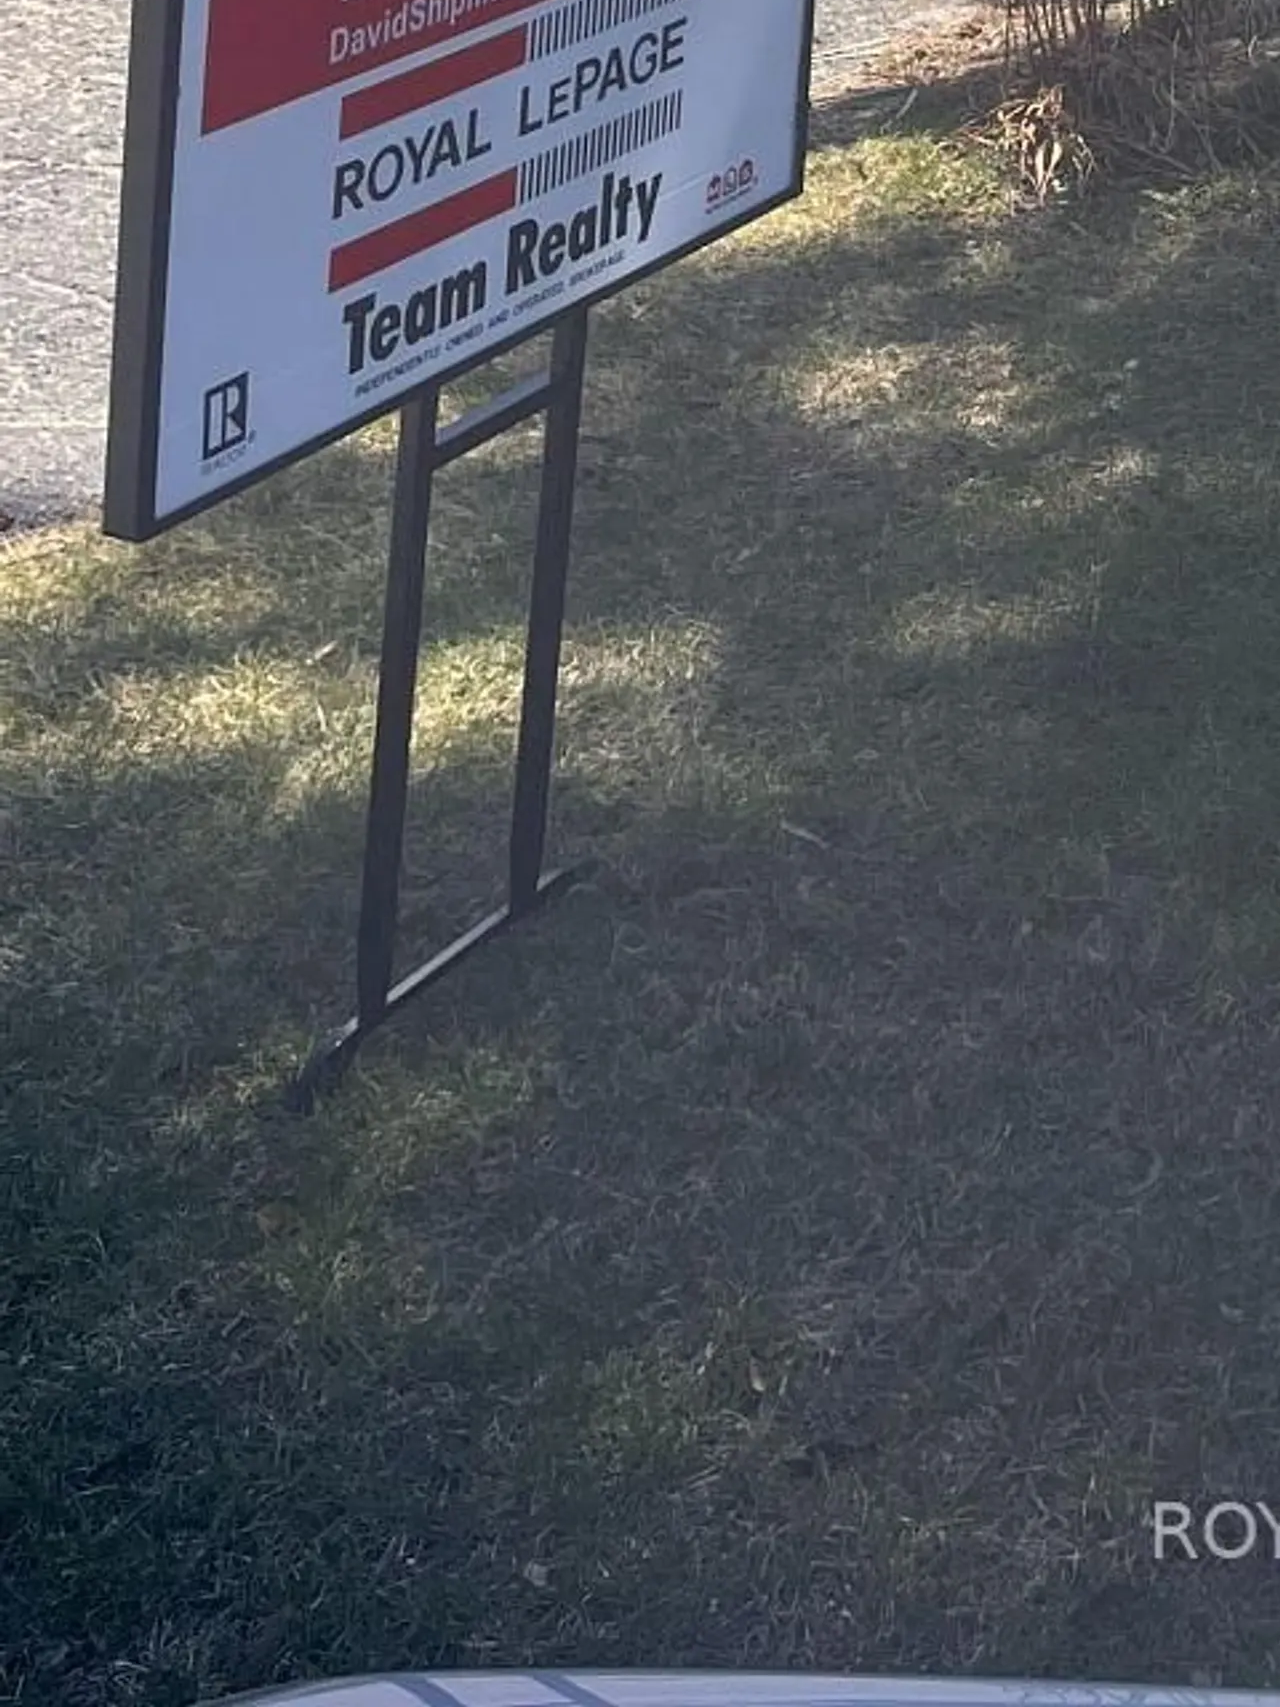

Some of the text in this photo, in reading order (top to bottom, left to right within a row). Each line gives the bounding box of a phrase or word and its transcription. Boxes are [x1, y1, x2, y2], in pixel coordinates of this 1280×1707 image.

[331, 108, 493, 219] ROYAL
[343, 261, 487, 373] Team
[505, 174, 662, 296] Realty
